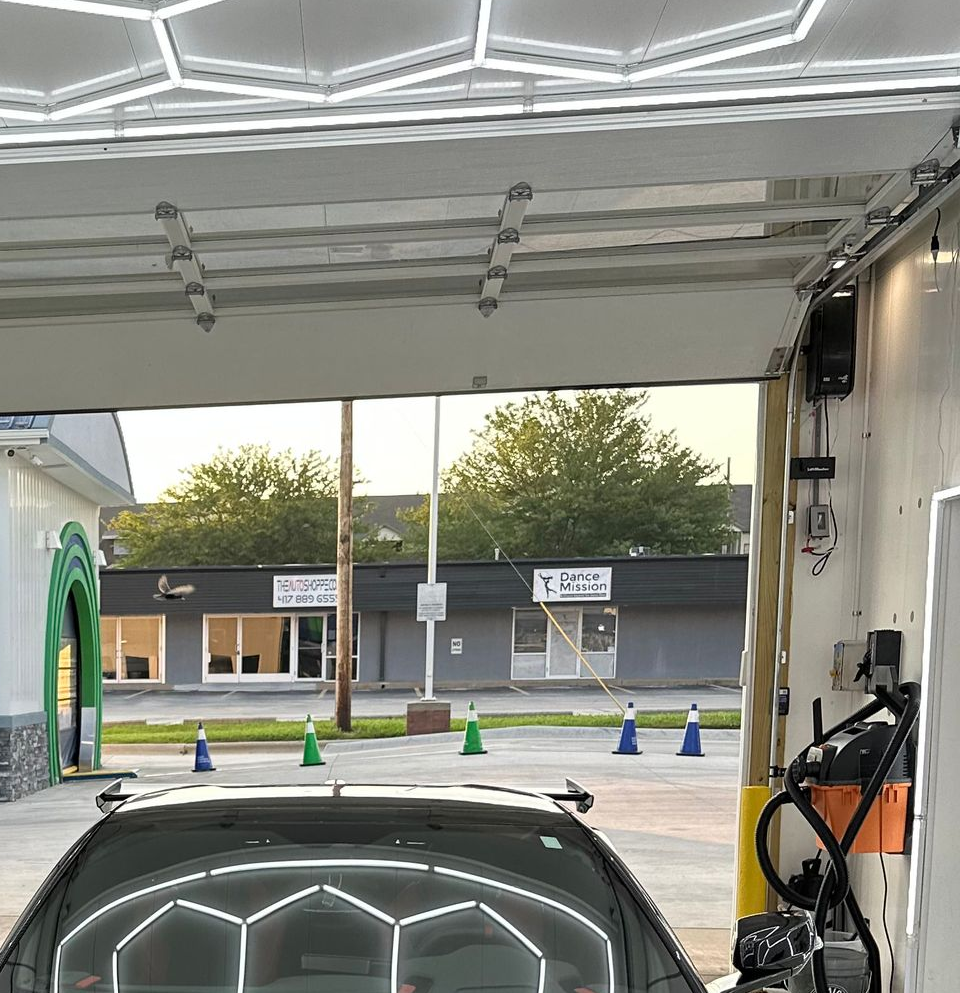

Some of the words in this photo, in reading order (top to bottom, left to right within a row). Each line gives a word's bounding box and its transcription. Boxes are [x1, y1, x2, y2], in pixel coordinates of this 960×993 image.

[560, 572, 600, 582] Dance
[560, 581, 608, 592] Mission
[277, 595, 294, 604] 417
[295, 594, 315, 604] 889
